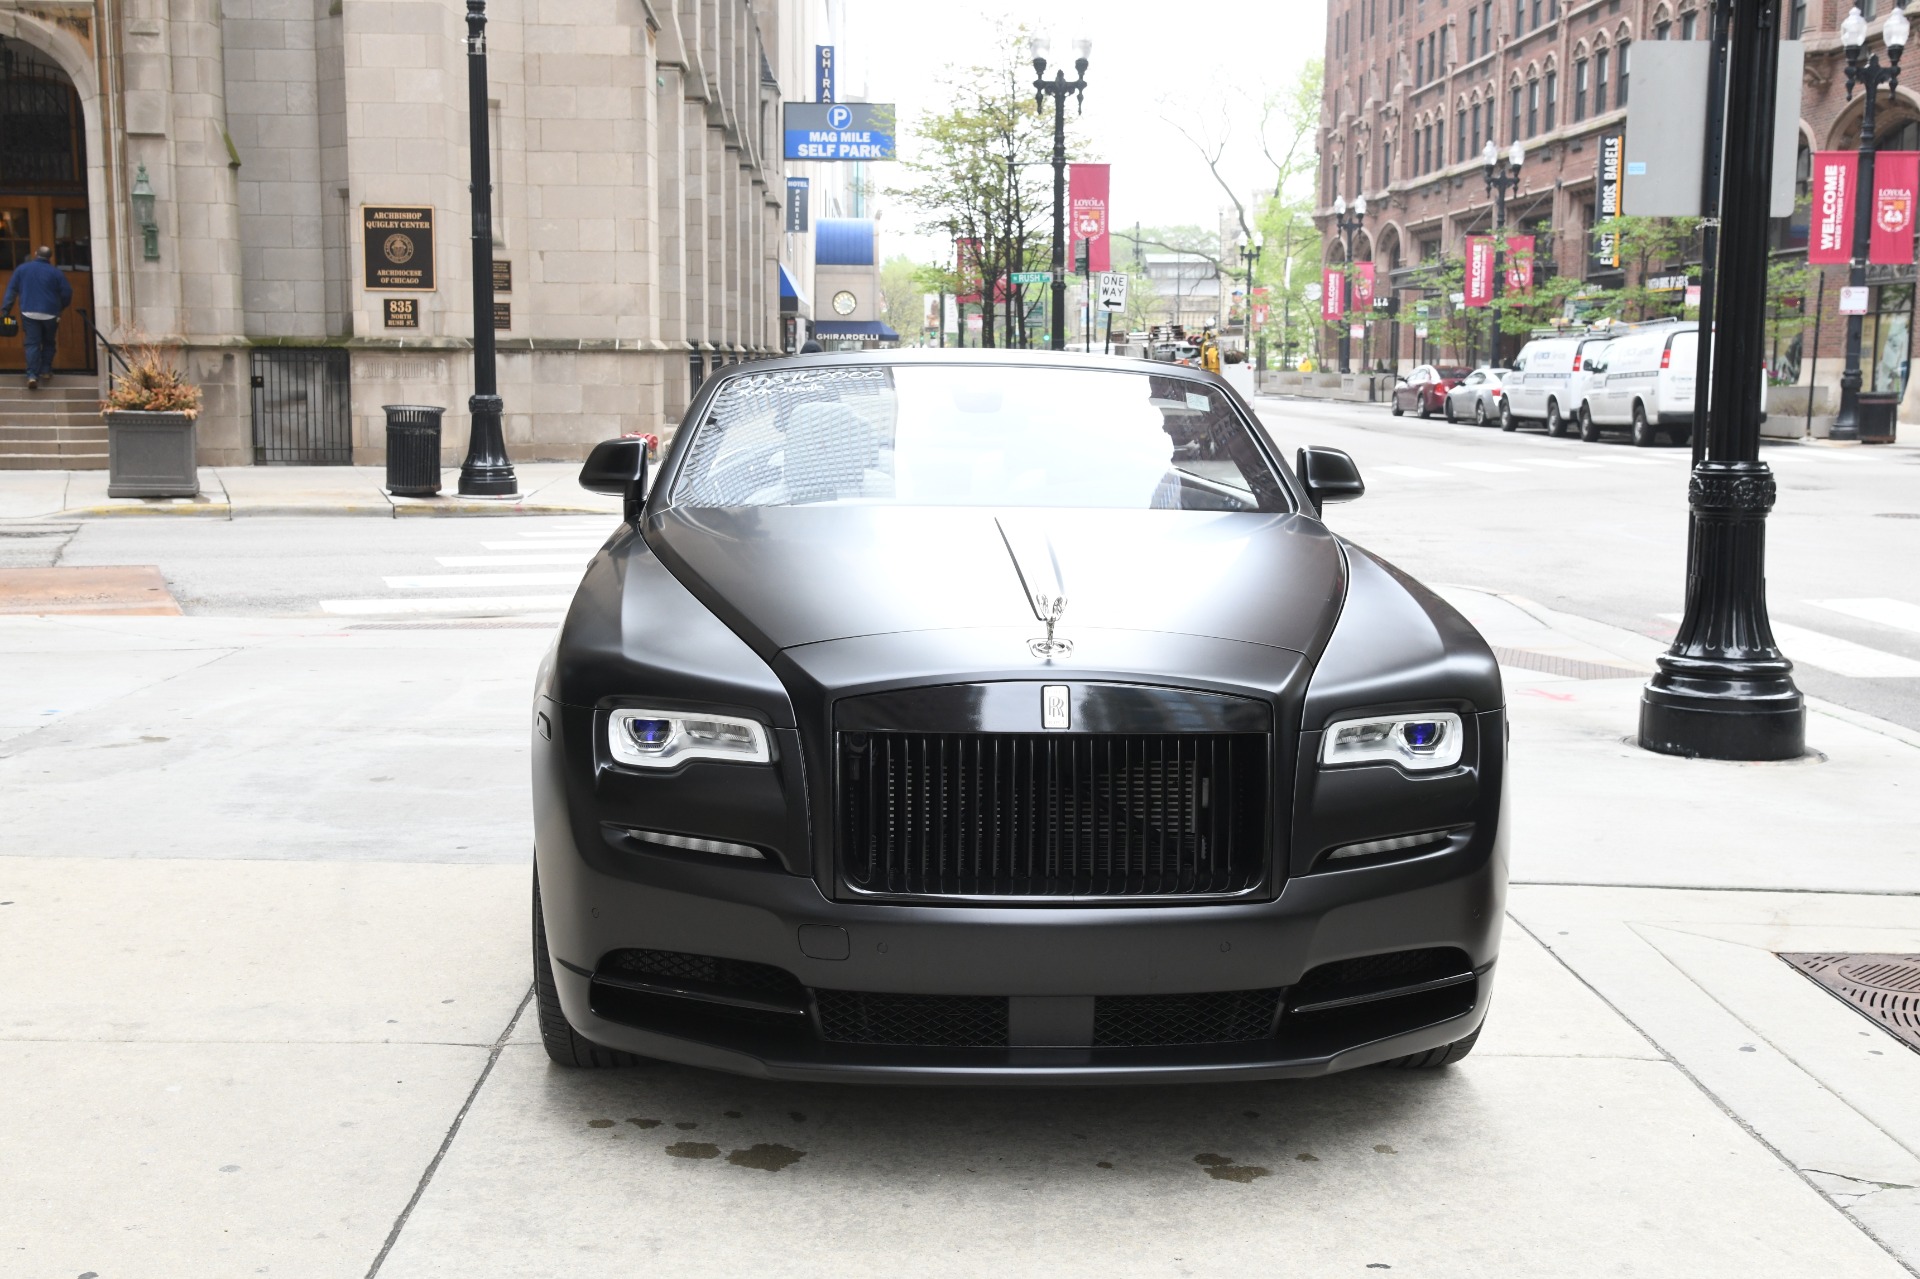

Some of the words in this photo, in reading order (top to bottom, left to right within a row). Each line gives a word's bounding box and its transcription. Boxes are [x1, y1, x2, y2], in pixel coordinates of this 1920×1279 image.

[833, 108, 847, 126] P
[809, 132, 838, 142] MAG
[841, 132, 871, 142] MILE
[798, 144, 834, 157] SELF
[839, 145, 882, 157] PARK
[1604, 138, 1619, 180] BAGELS
[1878, 188, 1911, 197] LOYOLA
[1074, 199, 1105, 207] LOYOLA
[1821, 165, 1838, 250] WELCOME
[374, 212, 422, 220] ARCHBISHOP
[366, 221, 399, 229] QUIGLEY
[400, 221, 430, 229] CENTER
[1019, 274, 1040, 282] RUSH
[1103, 275, 1124, 286] ONE
[1102, 286, 1125, 297] WAY
[390, 300, 413, 313] 835
[816, 333, 879, 341] GHIRARDELLI
